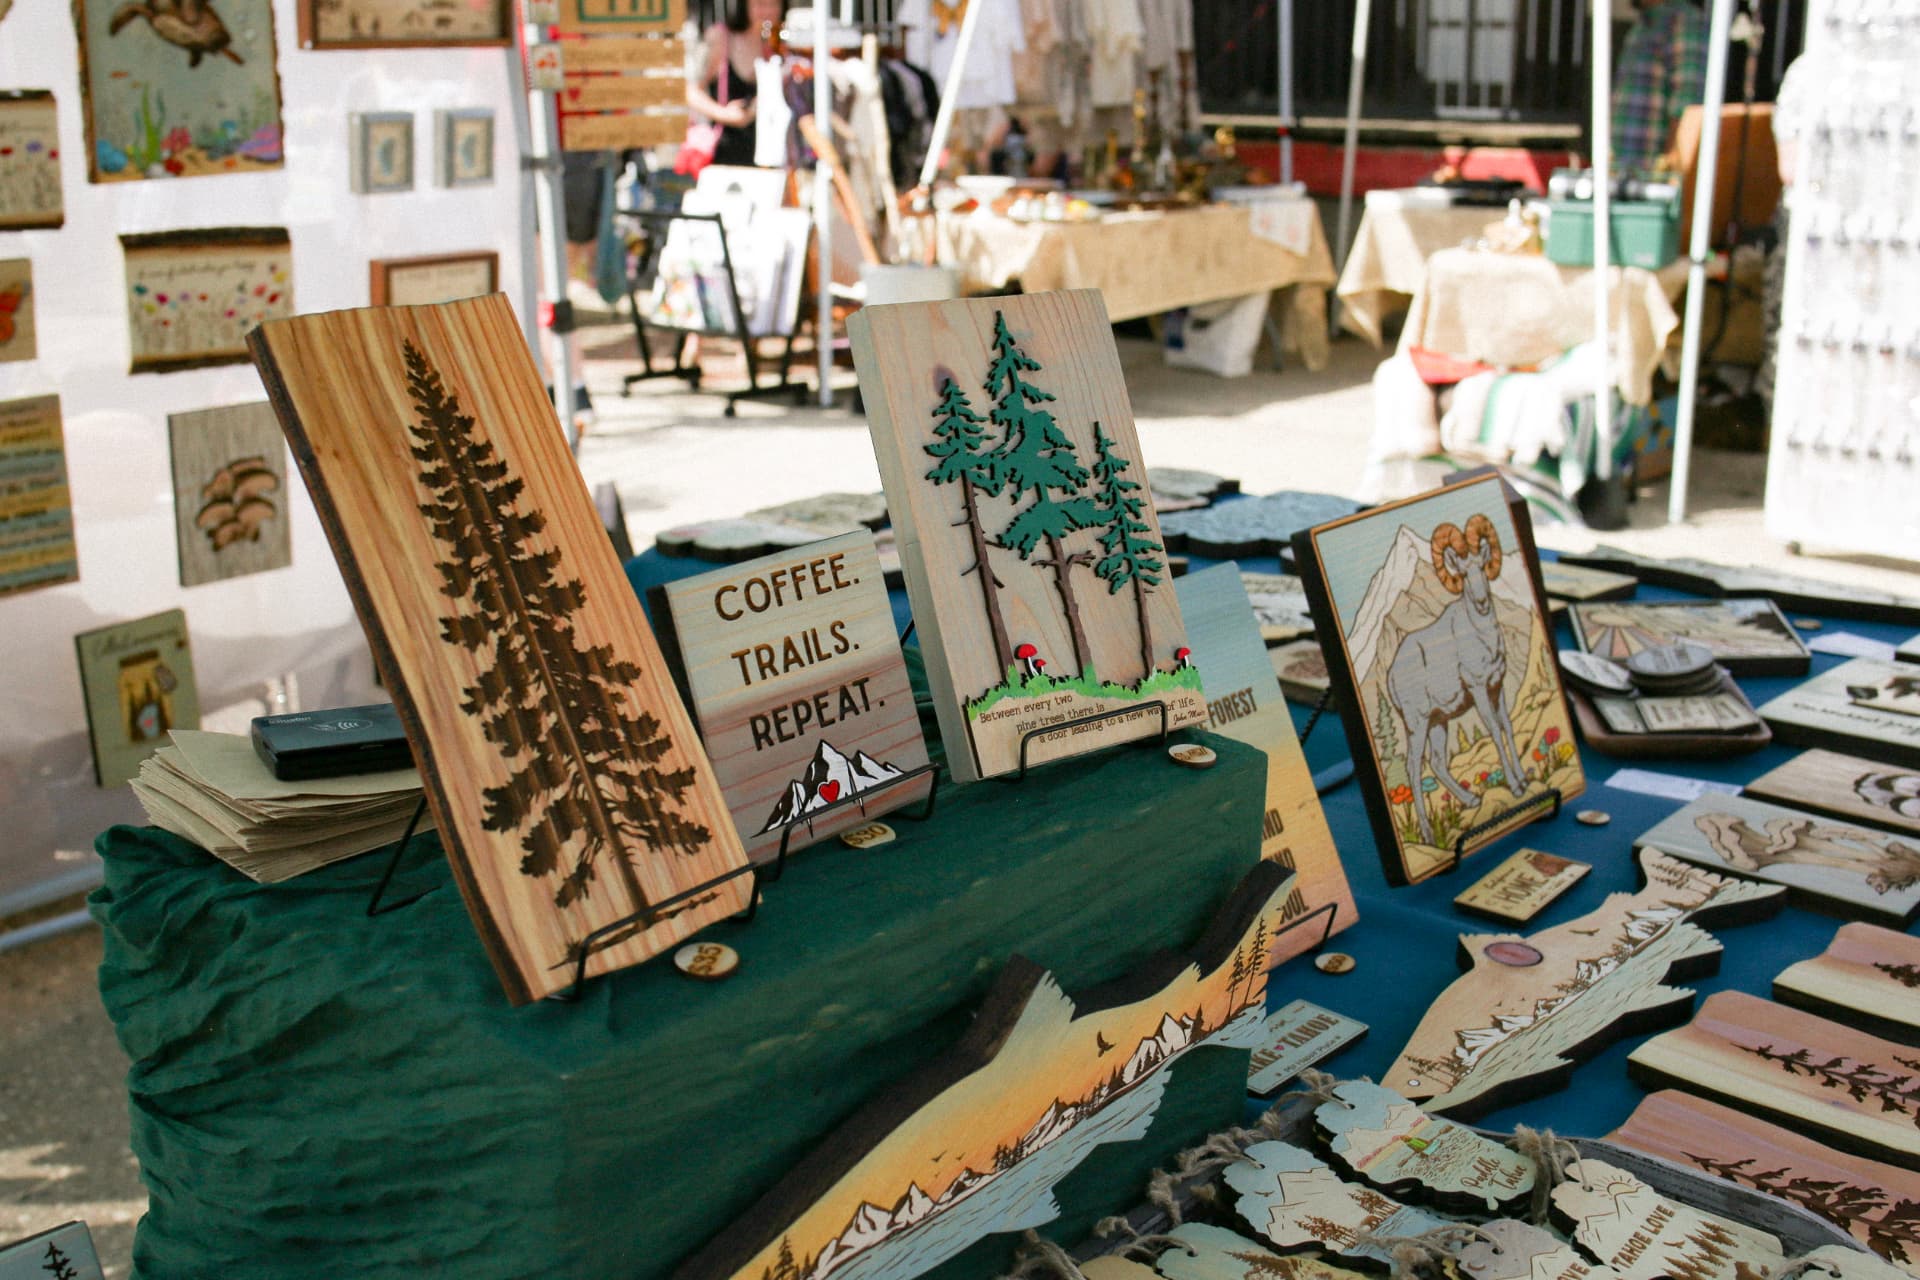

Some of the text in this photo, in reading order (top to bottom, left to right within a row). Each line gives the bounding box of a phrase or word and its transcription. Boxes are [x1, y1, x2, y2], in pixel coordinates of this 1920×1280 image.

[714, 553, 860, 622] COFFEE.
[731, 620, 860, 686] TRAILS.
[750, 677, 885, 752] REPEAT.
[979, 694, 1073, 724] Between every two
[1016, 703, 1105, 735] pine trees there is
[1039, 735, 1046, 743] a
[1047, 729, 1068, 742] door
[1071, 720, 1103, 736] leading
[1105, 718, 1116, 727] to
[1118, 716, 1124, 724] a
[1125, 711, 1144, 723] new
[1166, 701, 1176, 711] of
[1172, 712, 1187, 725] John
[1206, 687, 1258, 728] FOREST
[1492, 873, 1550, 904] HOME
[1247, 1048, 1284, 1079] AKE
[1277, 1012, 1340, 1049] TAHOE
[1461, 1156, 1501, 1190] Paddle
[1611, 1204, 1676, 1269] TAHOE LOVE
